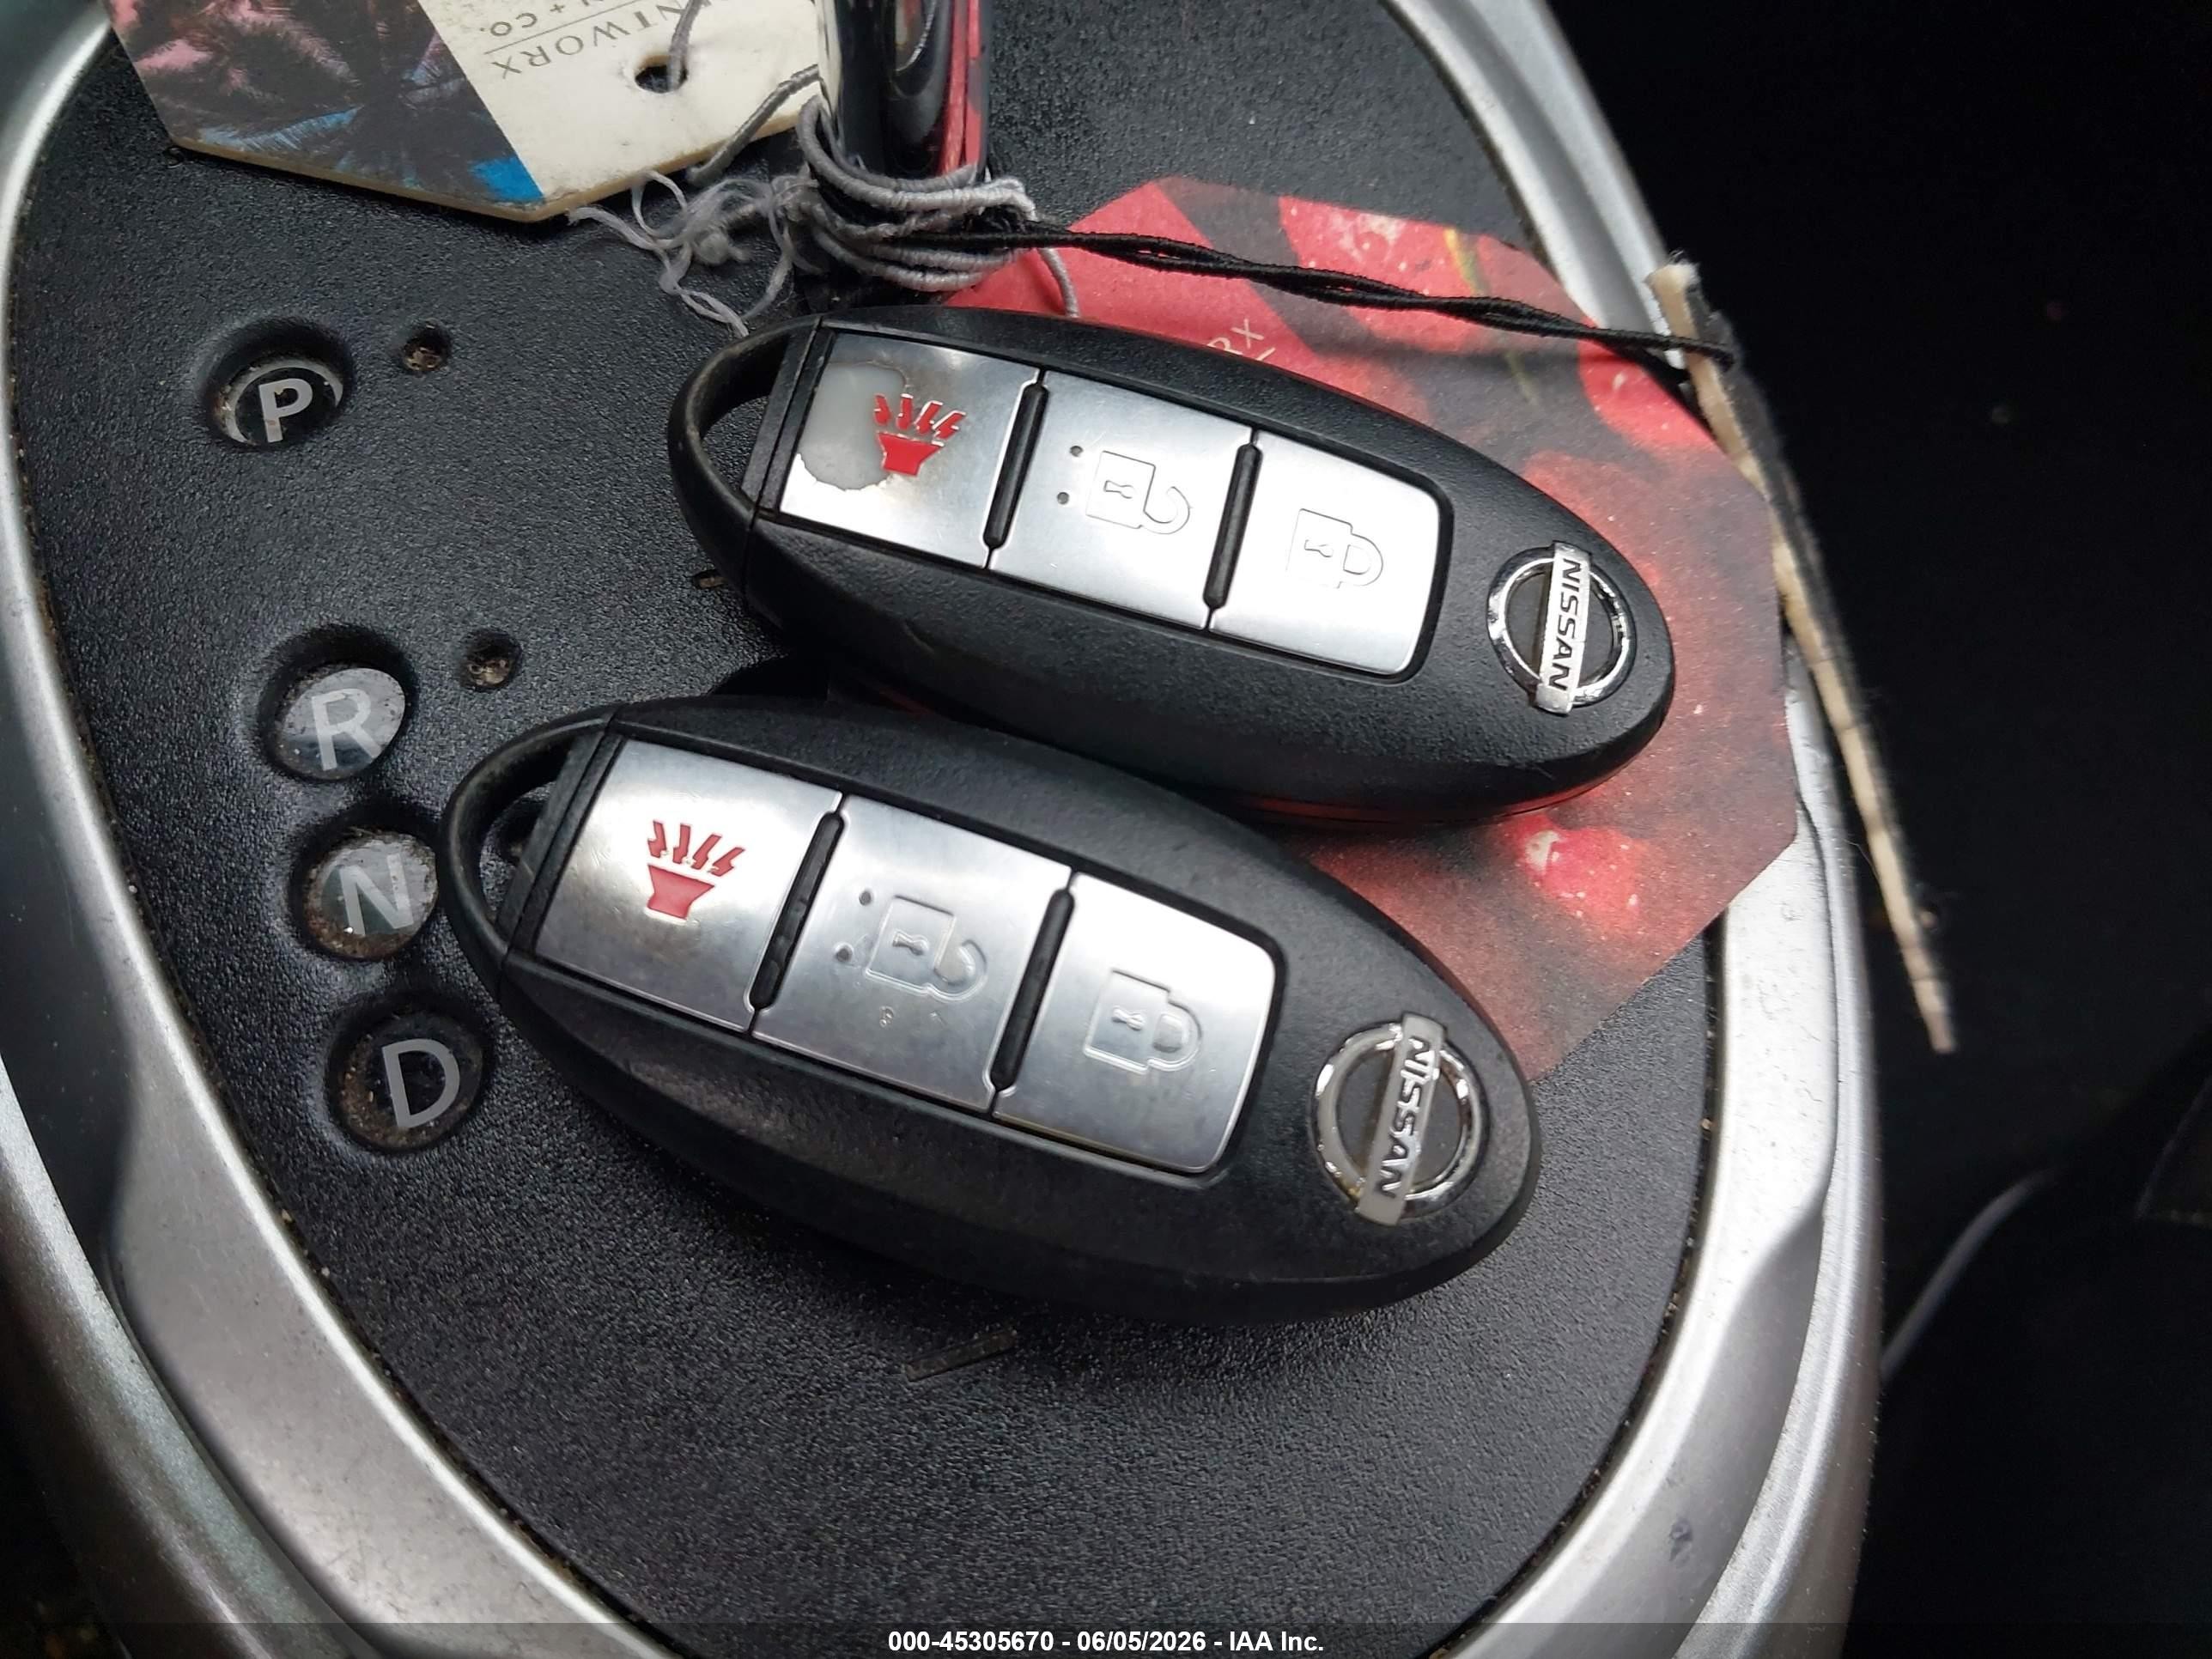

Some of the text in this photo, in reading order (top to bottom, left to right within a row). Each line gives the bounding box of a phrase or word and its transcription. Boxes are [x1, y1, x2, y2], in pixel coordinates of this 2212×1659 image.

[479, 12, 538, 37] CO.
[490, 0, 712, 79] NTWORX
[258, 377, 313, 444] P
[1548, 558, 1583, 691] NISSAN
[311, 686, 383, 771] R
[338, 852, 414, 937] N
[381, 1037, 461, 1131] D
[1376, 1036, 1437, 1200] NISSAN
